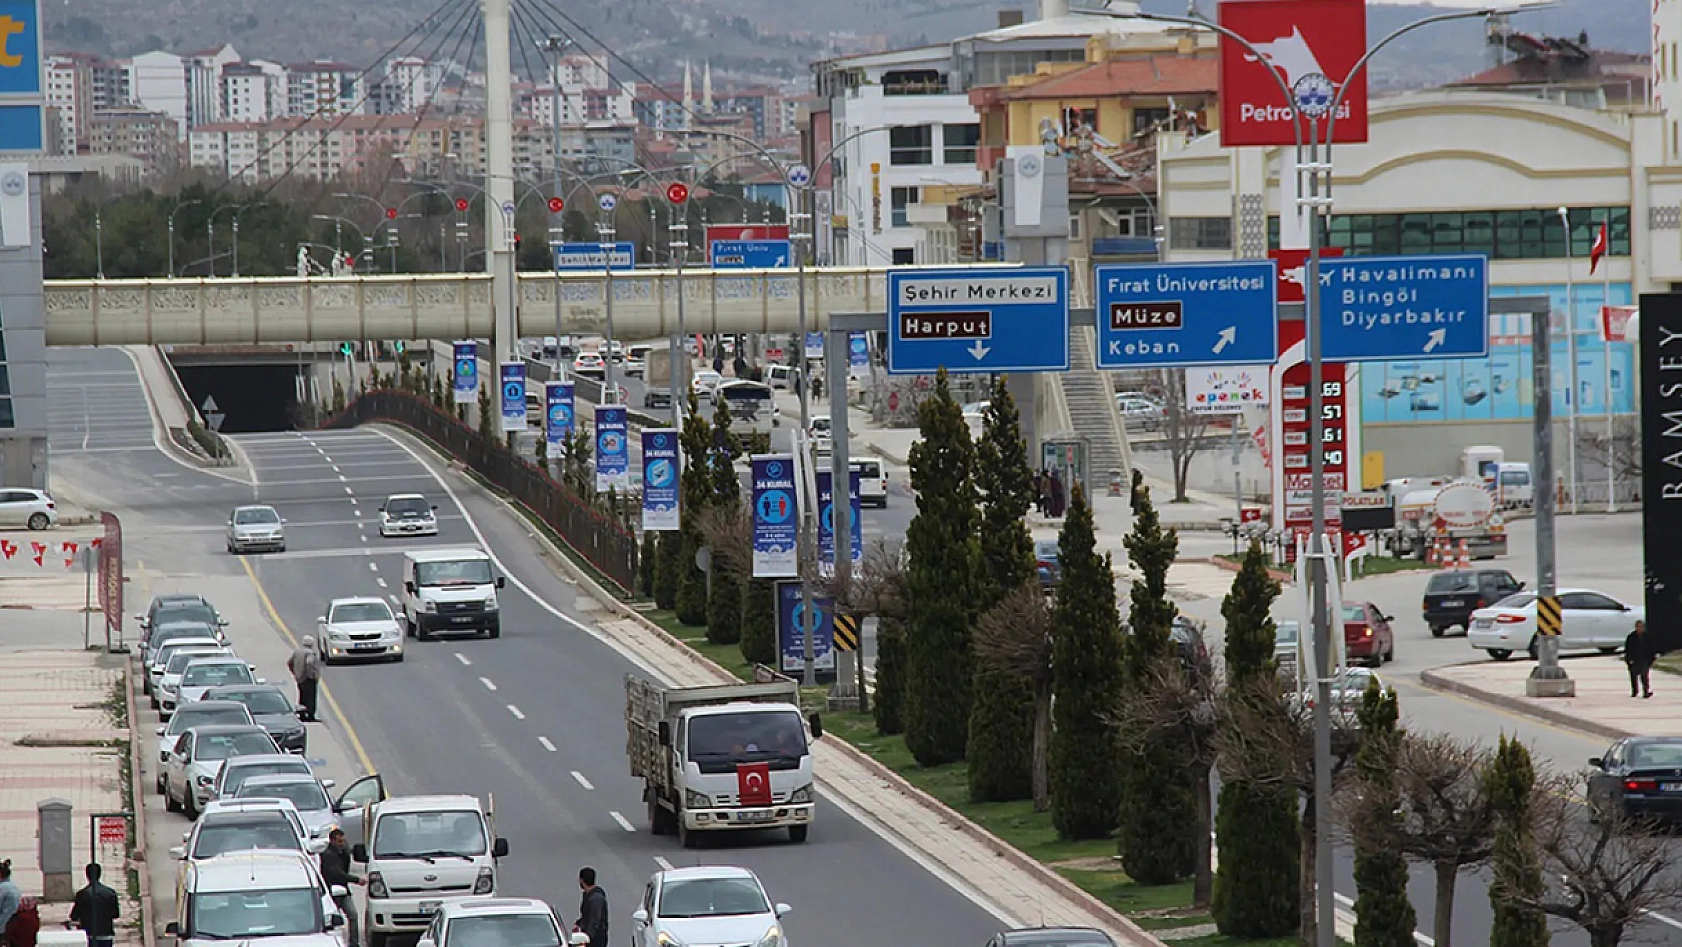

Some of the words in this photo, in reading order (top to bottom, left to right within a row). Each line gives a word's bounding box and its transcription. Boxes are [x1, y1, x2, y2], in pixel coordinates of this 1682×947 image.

[1241, 104, 1298, 121] Petro
[1108, 278, 1149, 293] Fırat
[1157, 274, 1265, 292] Üniversitesi
[1342, 266, 1475, 283] Havalimanı
[905, 285, 958, 301] Şehir
[968, 283, 1052, 299] Merkezi
[1342, 287, 1417, 306] Bingöl
[1115, 309, 1177, 324] Müze
[1342, 308, 1465, 331] Diyarbakır
[905, 318, 987, 336] Harput
[1109, 339, 1179, 356] Keban
